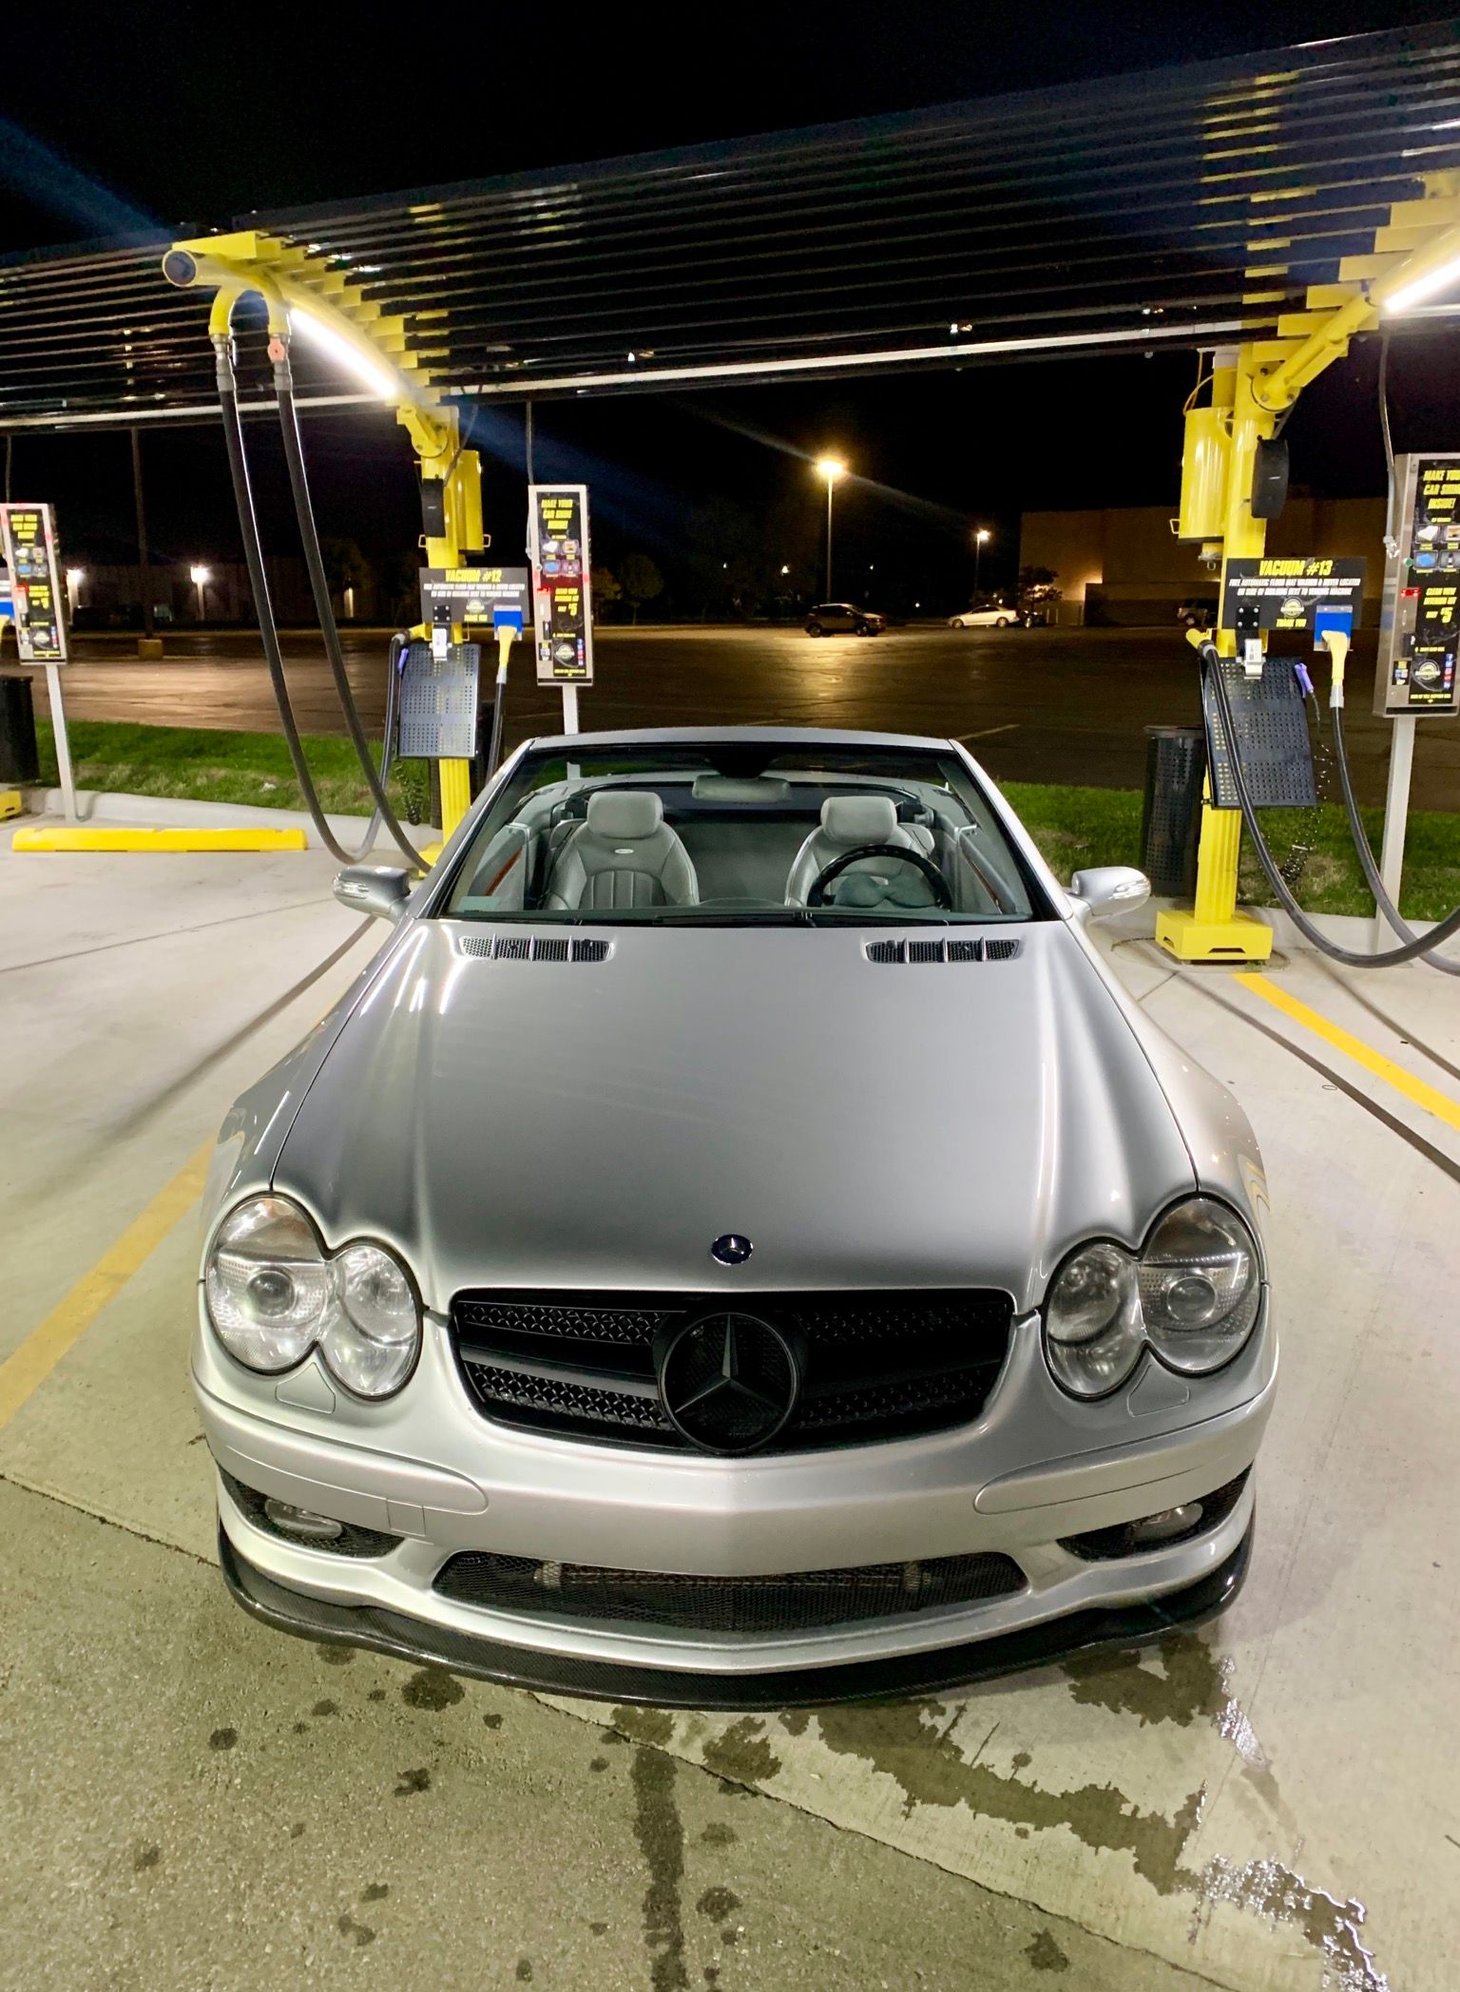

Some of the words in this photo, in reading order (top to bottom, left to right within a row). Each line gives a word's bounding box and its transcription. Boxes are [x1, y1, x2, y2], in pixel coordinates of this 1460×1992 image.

[1259, 560, 1305, 576] VACUUM
[1306, 560, 1333, 576] #13
[445, 569, 480, 582] VACUUM
[481, 569, 502, 582] #12
